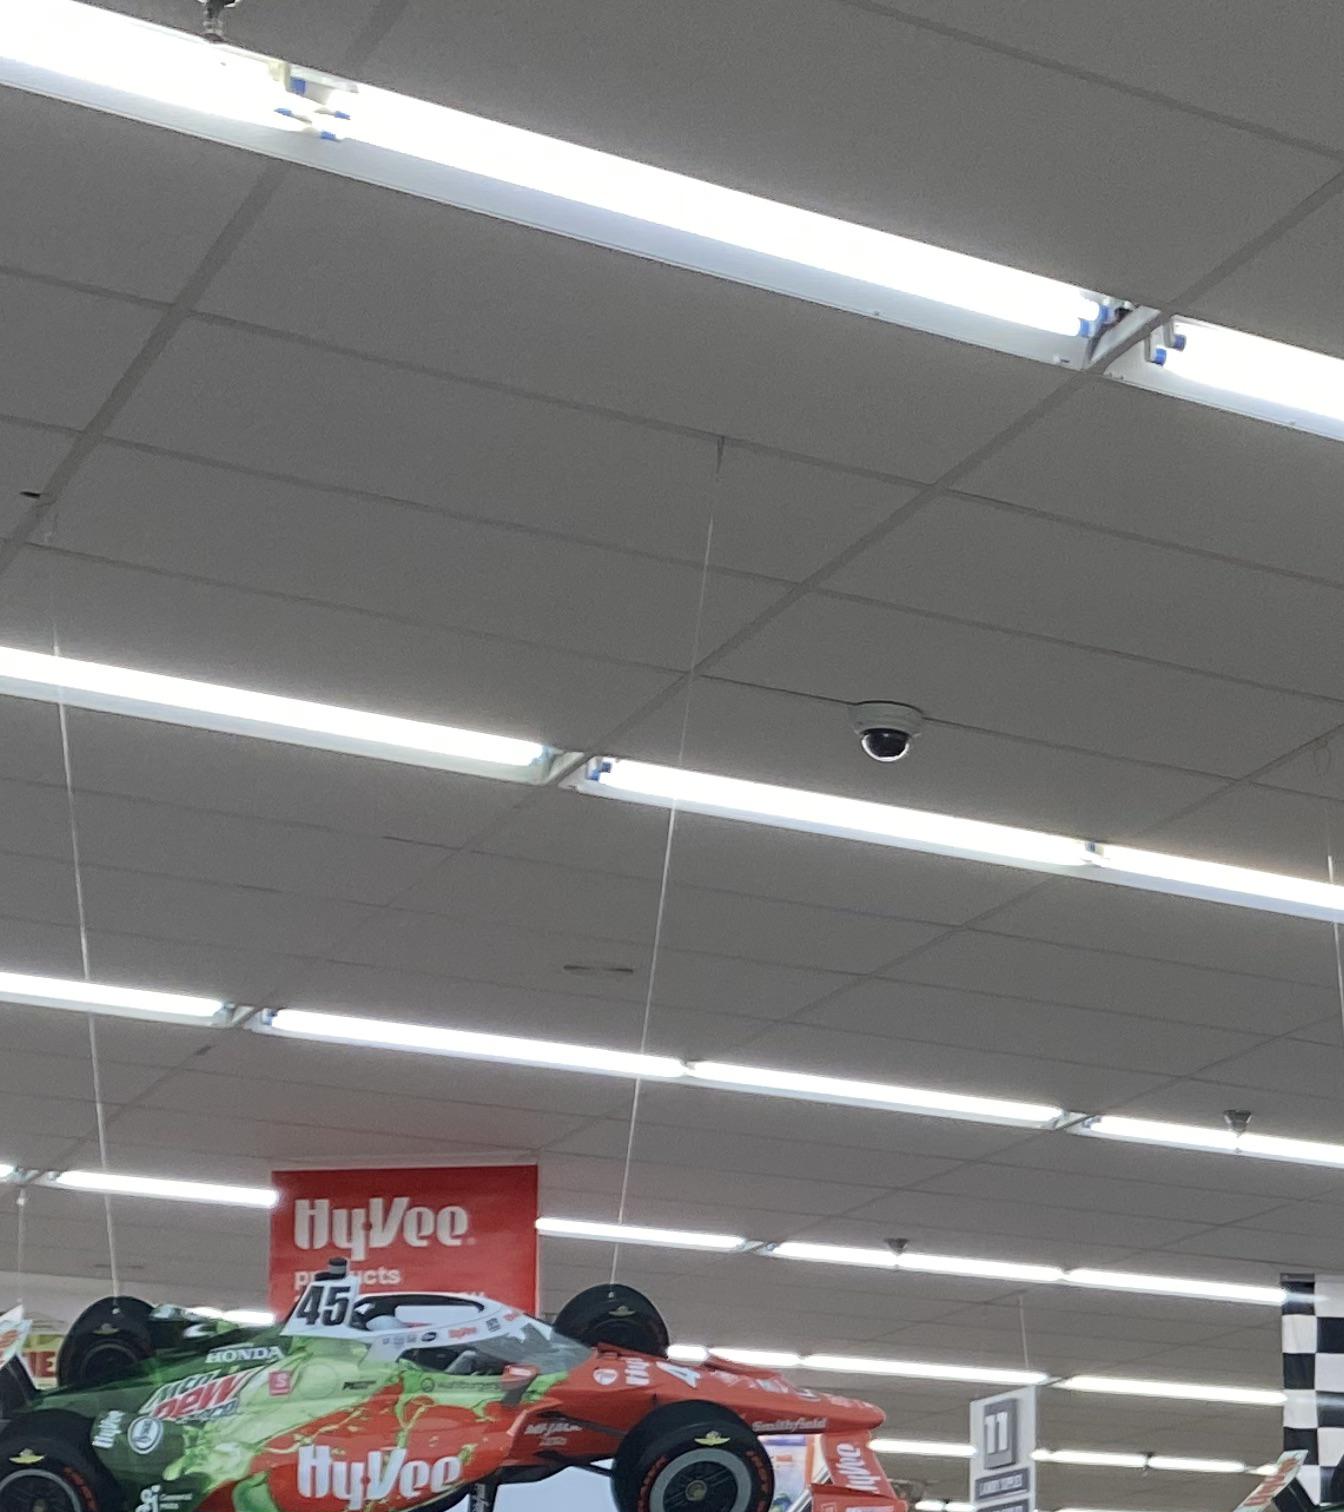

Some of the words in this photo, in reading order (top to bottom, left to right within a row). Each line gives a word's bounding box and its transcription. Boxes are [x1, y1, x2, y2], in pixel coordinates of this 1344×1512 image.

[294, 1196, 469, 1261] HyVee
[296, 1286, 351, 1326] 45
[205, 1345, 285, 1364] HONDA
[297, 1444, 462, 1511] HyVee
